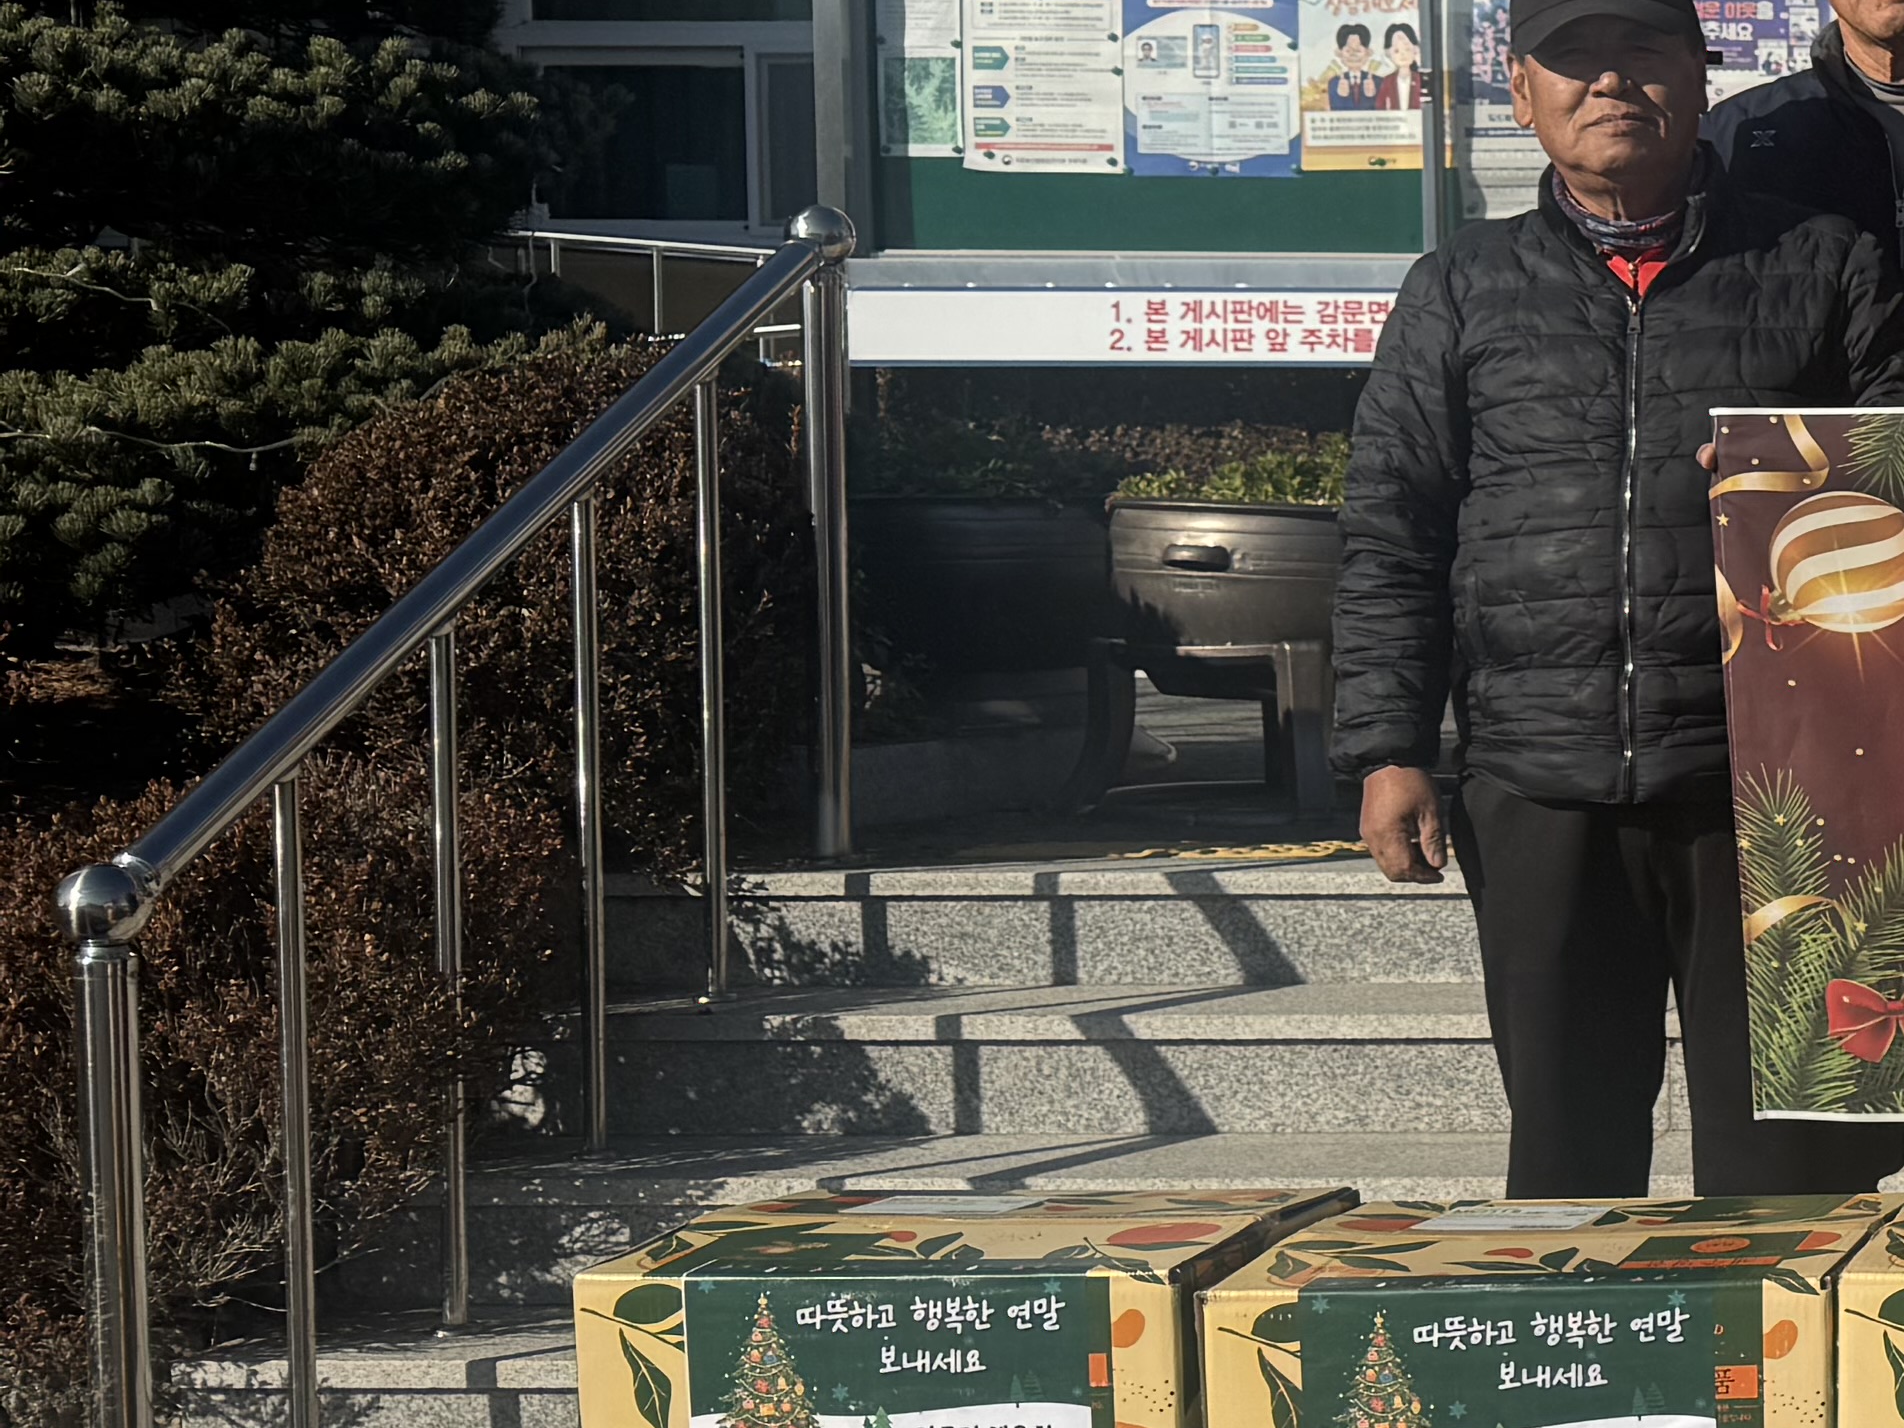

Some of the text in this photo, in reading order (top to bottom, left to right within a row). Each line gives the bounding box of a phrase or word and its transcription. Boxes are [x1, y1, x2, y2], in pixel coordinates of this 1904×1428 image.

[1144, 300, 1169, 323] 본
[1179, 299, 1305, 324] 게시판에는
[1144, 328, 1169, 352] 본
[1179, 327, 1256, 353] 게시판
[1264, 327, 1290, 353] 앞
[1298, 327, 1376, 354] 주차를
[794, 1293, 1066, 1335] 따뜻하고 행복한 연말
[878, 1344, 988, 1375] 보내세요
